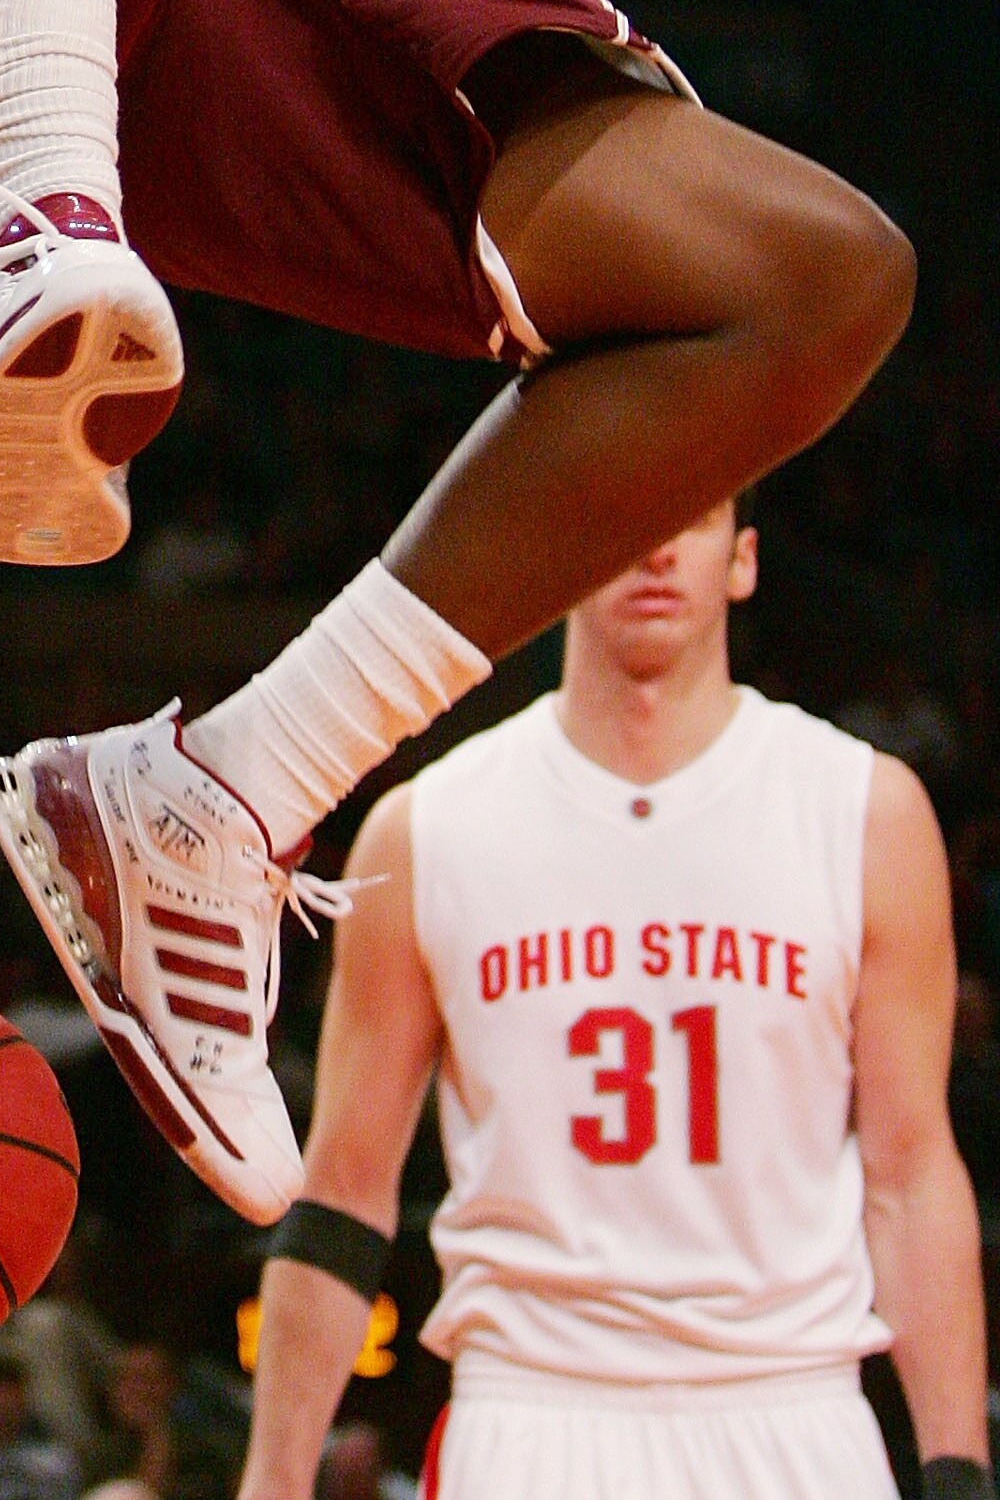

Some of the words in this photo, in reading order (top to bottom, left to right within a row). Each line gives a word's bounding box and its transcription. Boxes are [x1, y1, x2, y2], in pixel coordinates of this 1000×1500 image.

[480, 924, 615, 1002] OHIO
[640, 922, 808, 1000] STATE
[567, 1004, 721, 1165] 31
